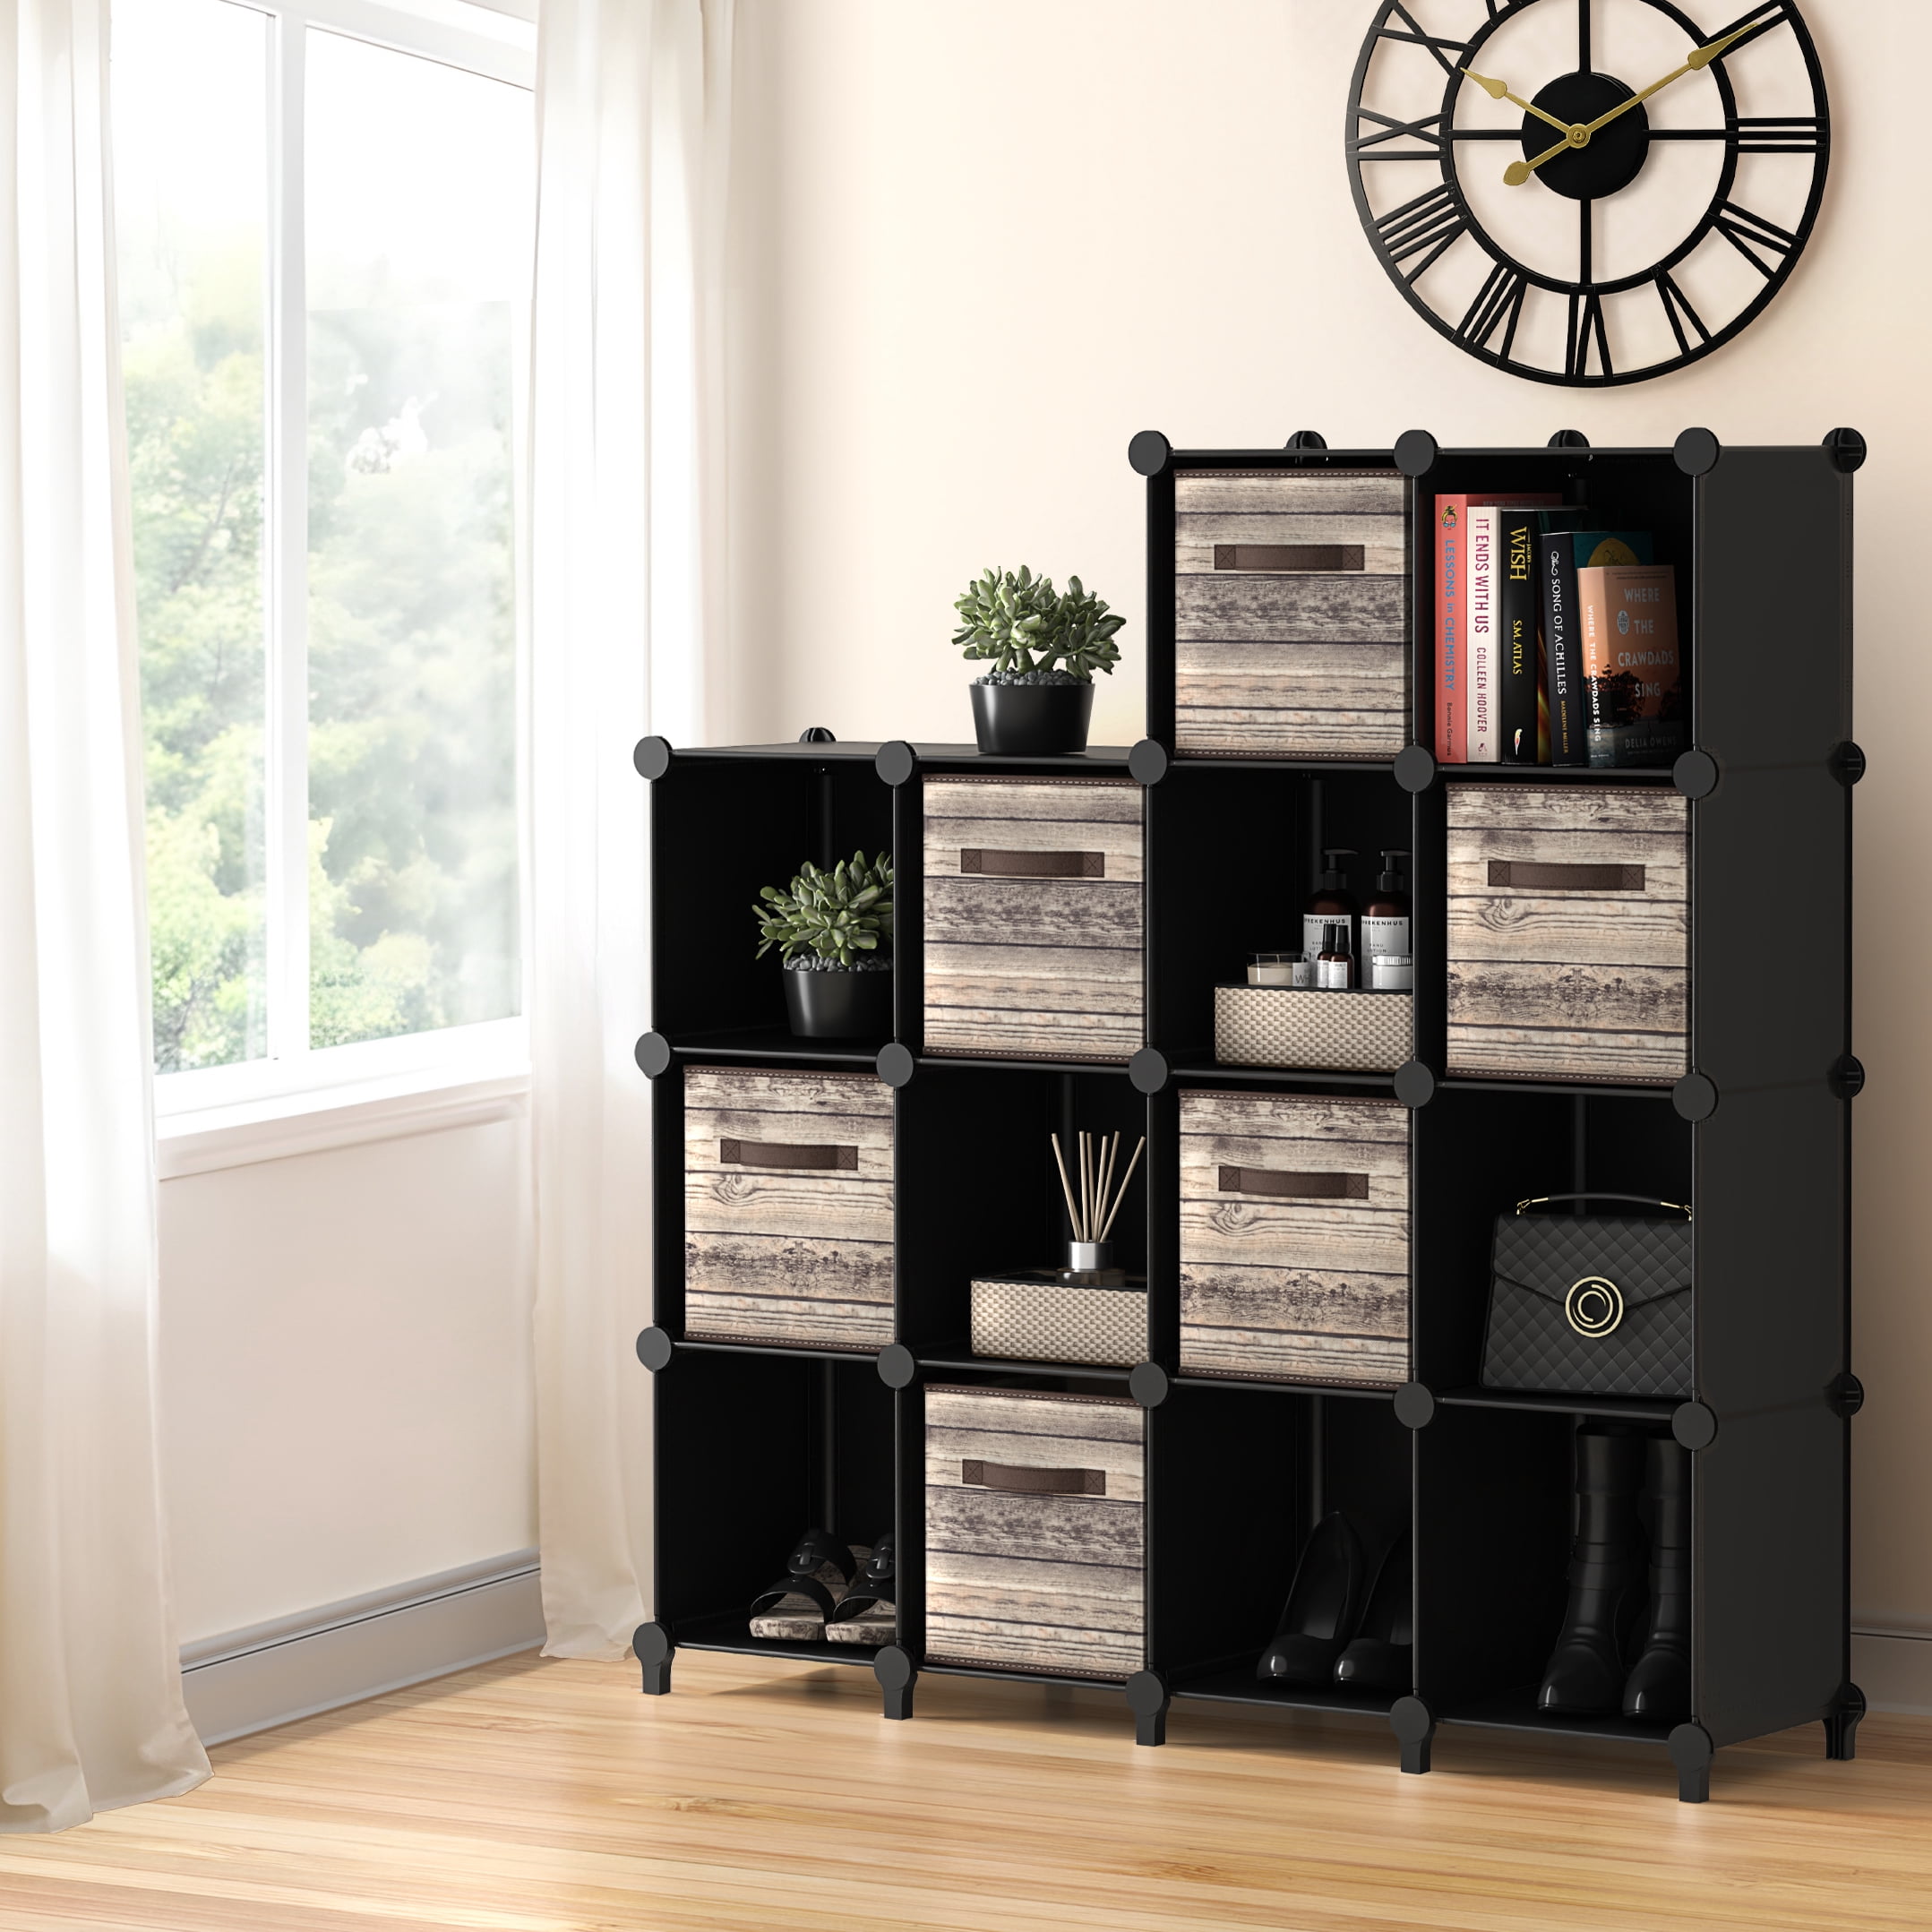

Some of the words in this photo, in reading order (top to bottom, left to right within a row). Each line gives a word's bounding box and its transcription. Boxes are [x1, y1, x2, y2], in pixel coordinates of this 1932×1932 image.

[1475, 519, 1490, 530] IT
[1445, 540, 1455, 597] LESSONS
[1475, 535, 1489, 571] ENDS
[1510, 526, 1527, 580] WISH
[1447, 603, 1455, 613] in
[1474, 575, 1489, 610] WITH
[1551, 579, 1562, 612] SONG
[1624, 588, 1661, 603] WHERE
[1474, 615, 1489, 633] US
[1553, 615, 1563, 631] OF
[1587, 605, 1595, 638] WHERE
[1634, 619, 1655, 635] THE
[1445, 617, 1455, 691] CHEMISTRY
[1477, 647, 1487, 689] COLLEEN
[1513, 642, 1523, 675] ATLAS
[1555, 634, 1567, 695] ACHILLES
[1618, 650, 1674, 666] CRAWDADS
[1591, 664, 1600, 715] CRAWDADS
[1635, 682, 1661, 698] SING
[1477, 693, 1487, 733] HOOVER
[1593, 717, 1601, 742] SING
[1625, 738, 1647, 749] DELIA
